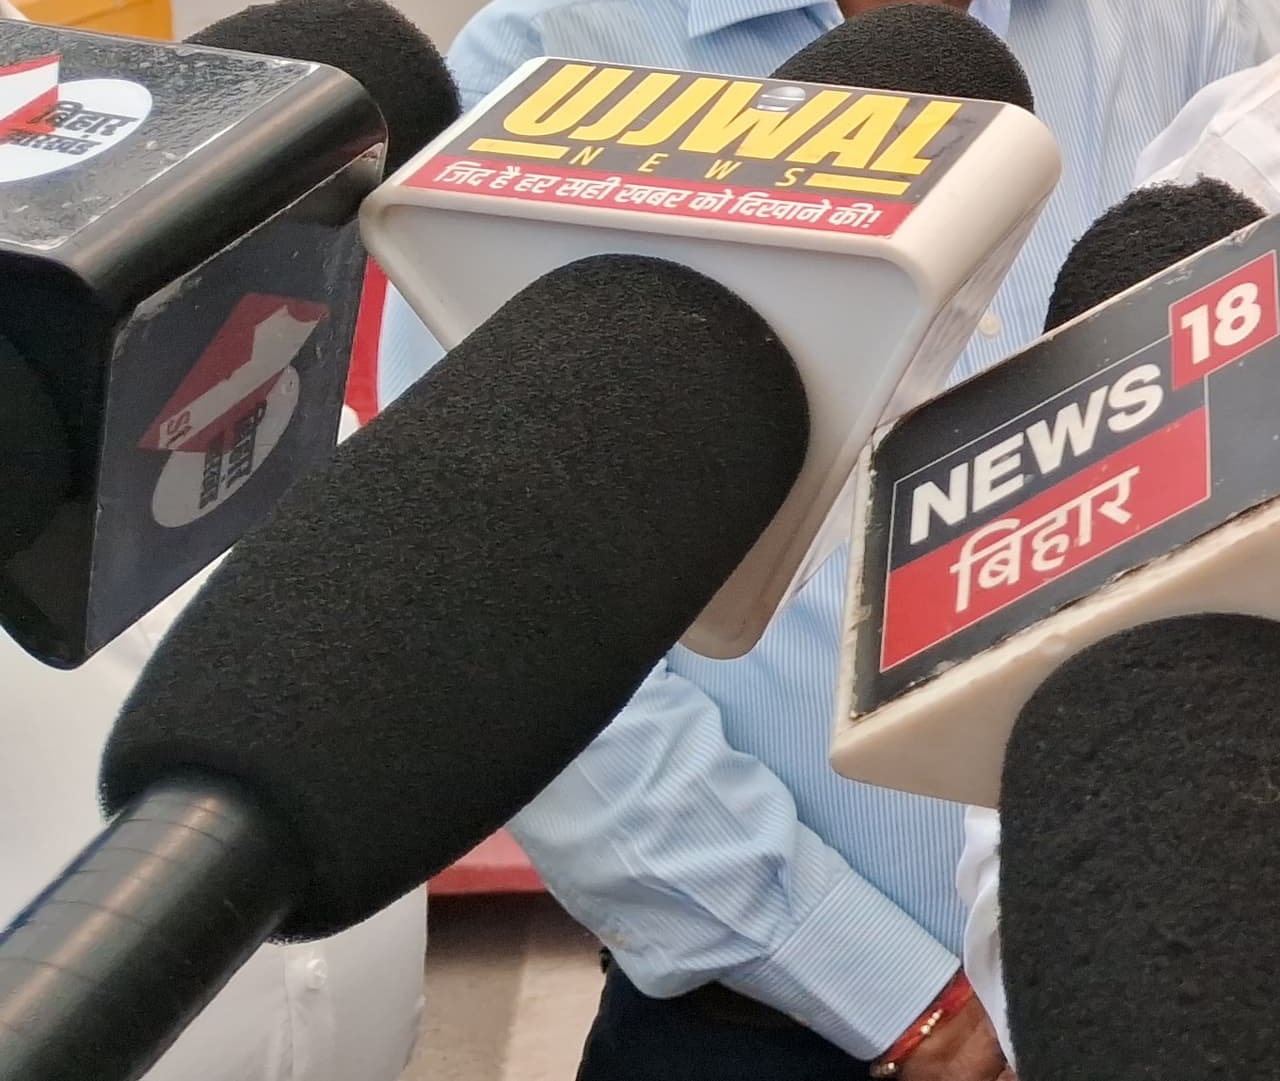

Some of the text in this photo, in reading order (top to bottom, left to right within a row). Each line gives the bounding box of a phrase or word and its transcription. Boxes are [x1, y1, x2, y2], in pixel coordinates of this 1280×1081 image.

[501, 63, 965, 176] UJJWAL
[570, 146, 810, 190] NEWS
[488, 164, 522, 192] है
[517, 172, 556, 202] हर
[557, 173, 616, 204] सही
[614, 182, 690, 214] खबर
[689, 183, 733, 215] को
[728, 188, 834, 224] दिखाने
[909, 281, 1262, 546] NEWS 18
[950, 466, 1140, 614] बिहार
